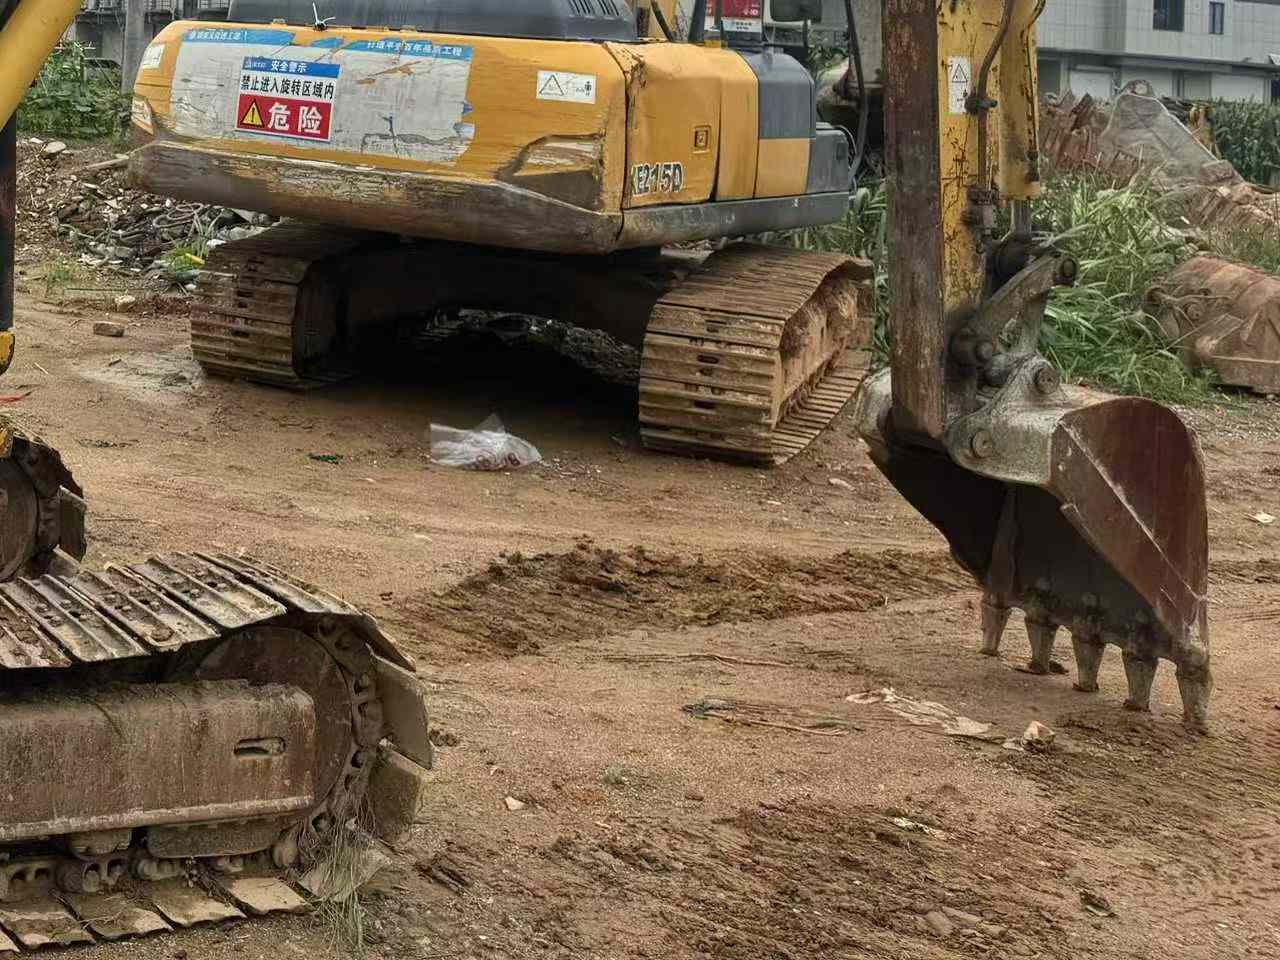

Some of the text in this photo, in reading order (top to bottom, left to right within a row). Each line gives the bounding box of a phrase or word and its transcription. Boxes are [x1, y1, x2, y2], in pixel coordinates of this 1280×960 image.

[271, 60, 307, 73] 安全警示
[241, 75, 334, 99] 禁止进入旋转区域内
[267, 101, 323, 134] 危险
